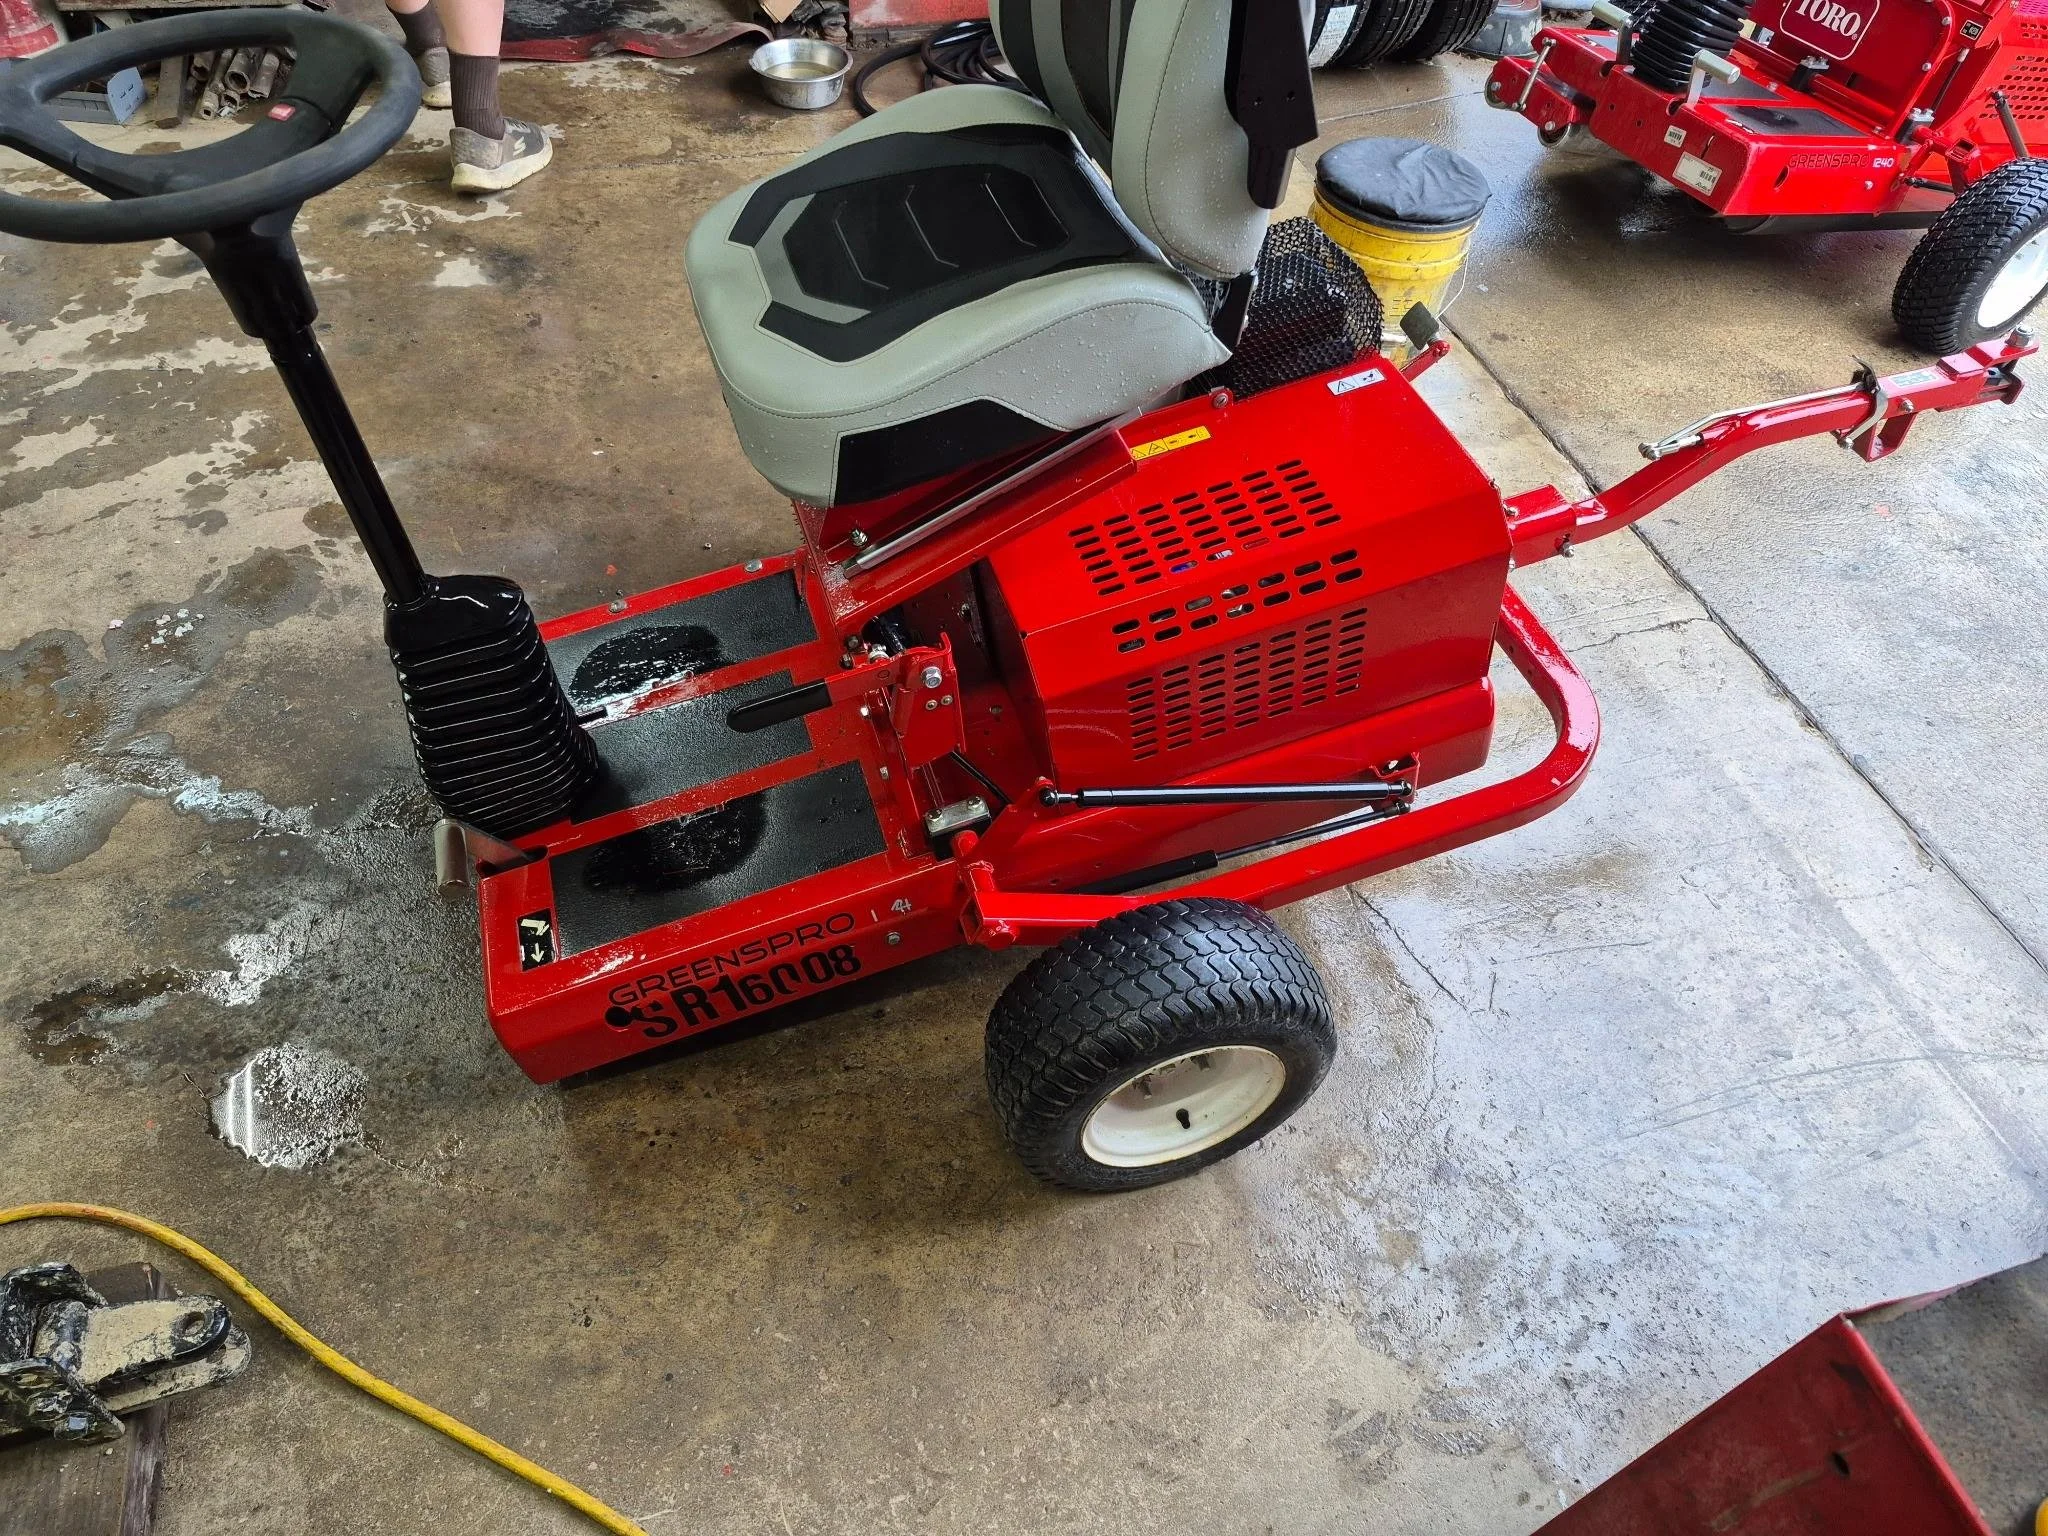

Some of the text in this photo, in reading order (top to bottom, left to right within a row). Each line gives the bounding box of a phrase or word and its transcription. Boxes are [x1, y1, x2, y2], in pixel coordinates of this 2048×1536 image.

[1795, 0, 1861, 37] TORO
[1788, 153, 1895, 169] GREENSPRO 1240
[608, 911, 855, 1007] GREENSPRO
[638, 943, 863, 1039] SR16008
